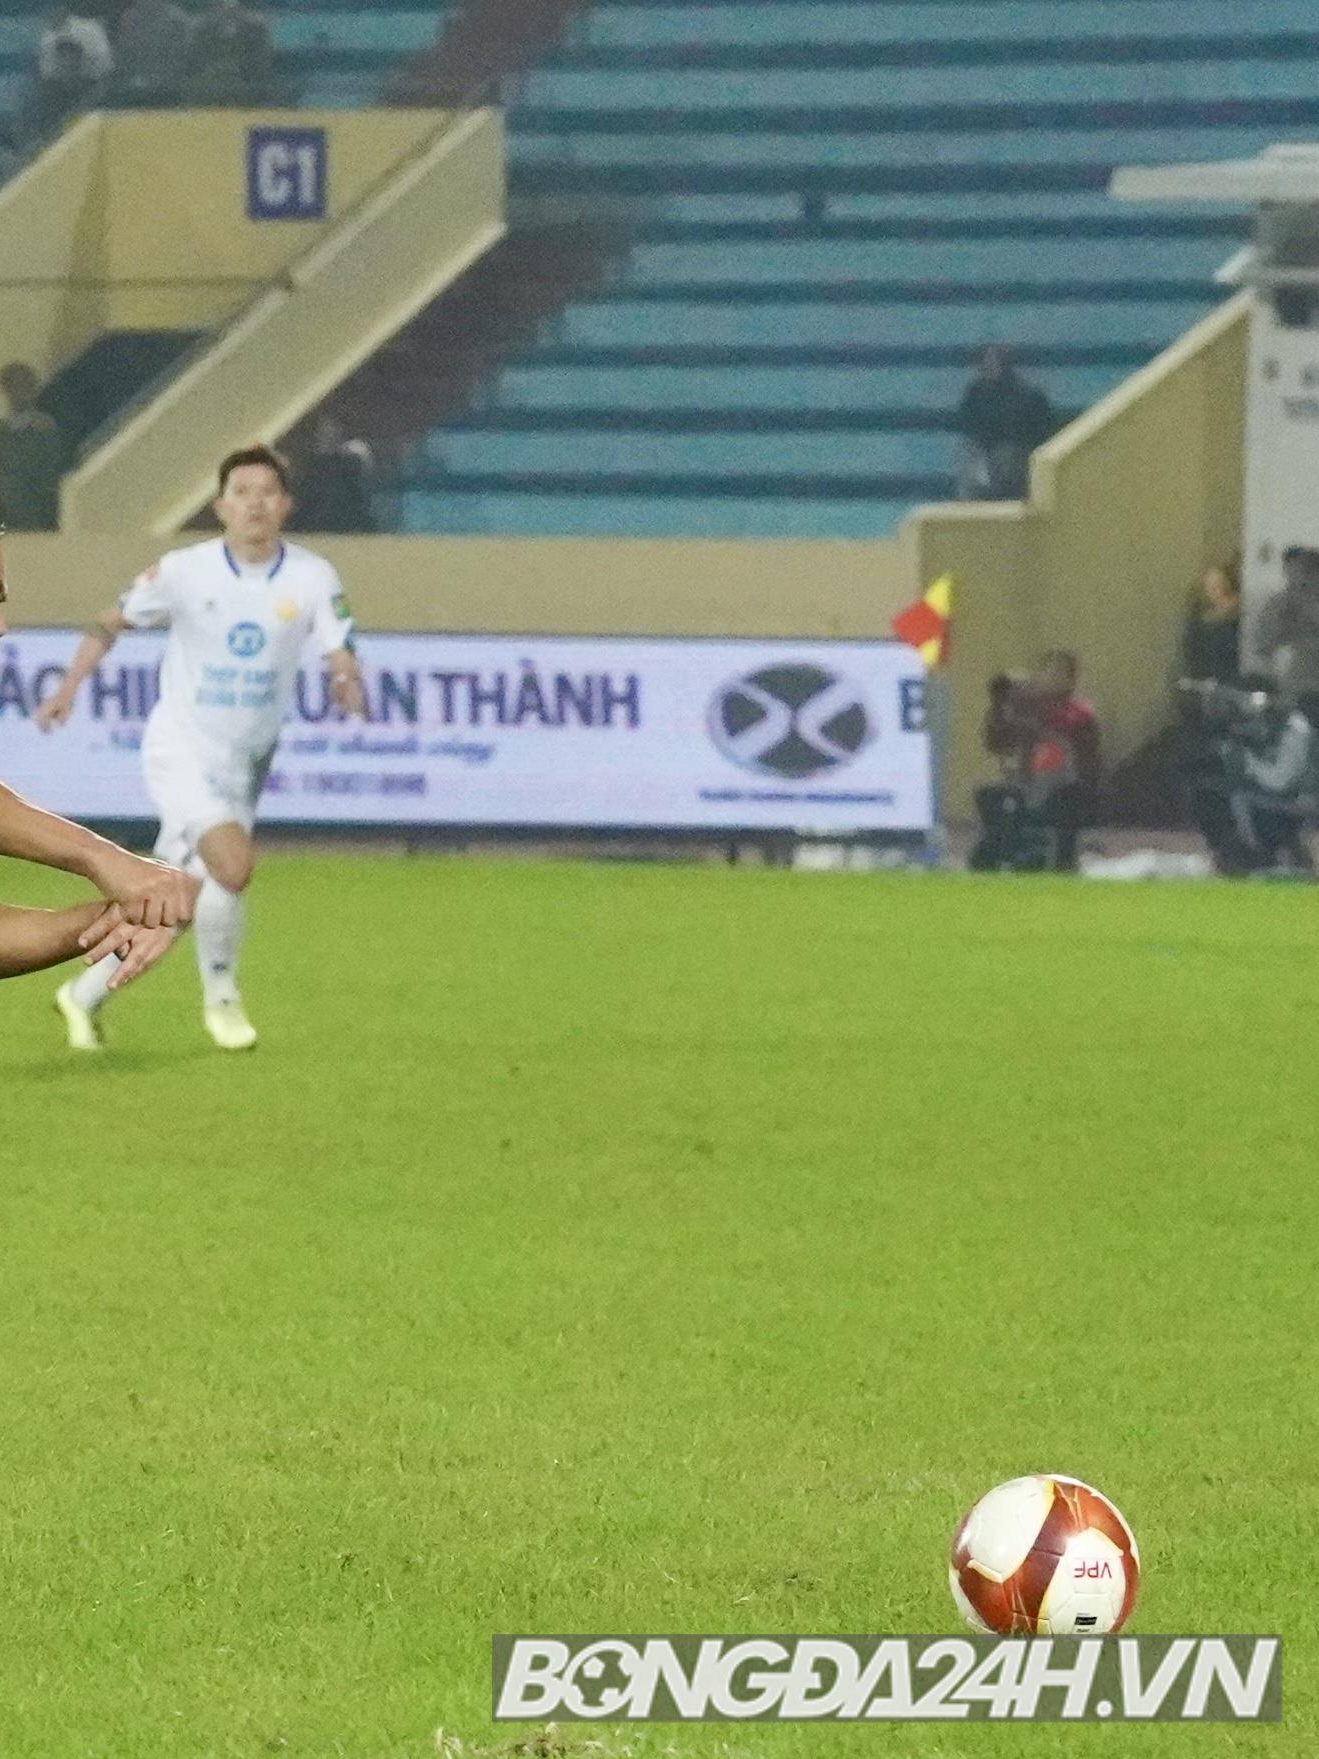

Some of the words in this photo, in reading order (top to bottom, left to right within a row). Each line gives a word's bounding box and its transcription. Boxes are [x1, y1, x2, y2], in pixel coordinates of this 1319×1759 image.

[258, 142, 316, 205] C1
[431, 656, 641, 727] THÀNH
[1074, 1560, 1112, 1579] VPF
